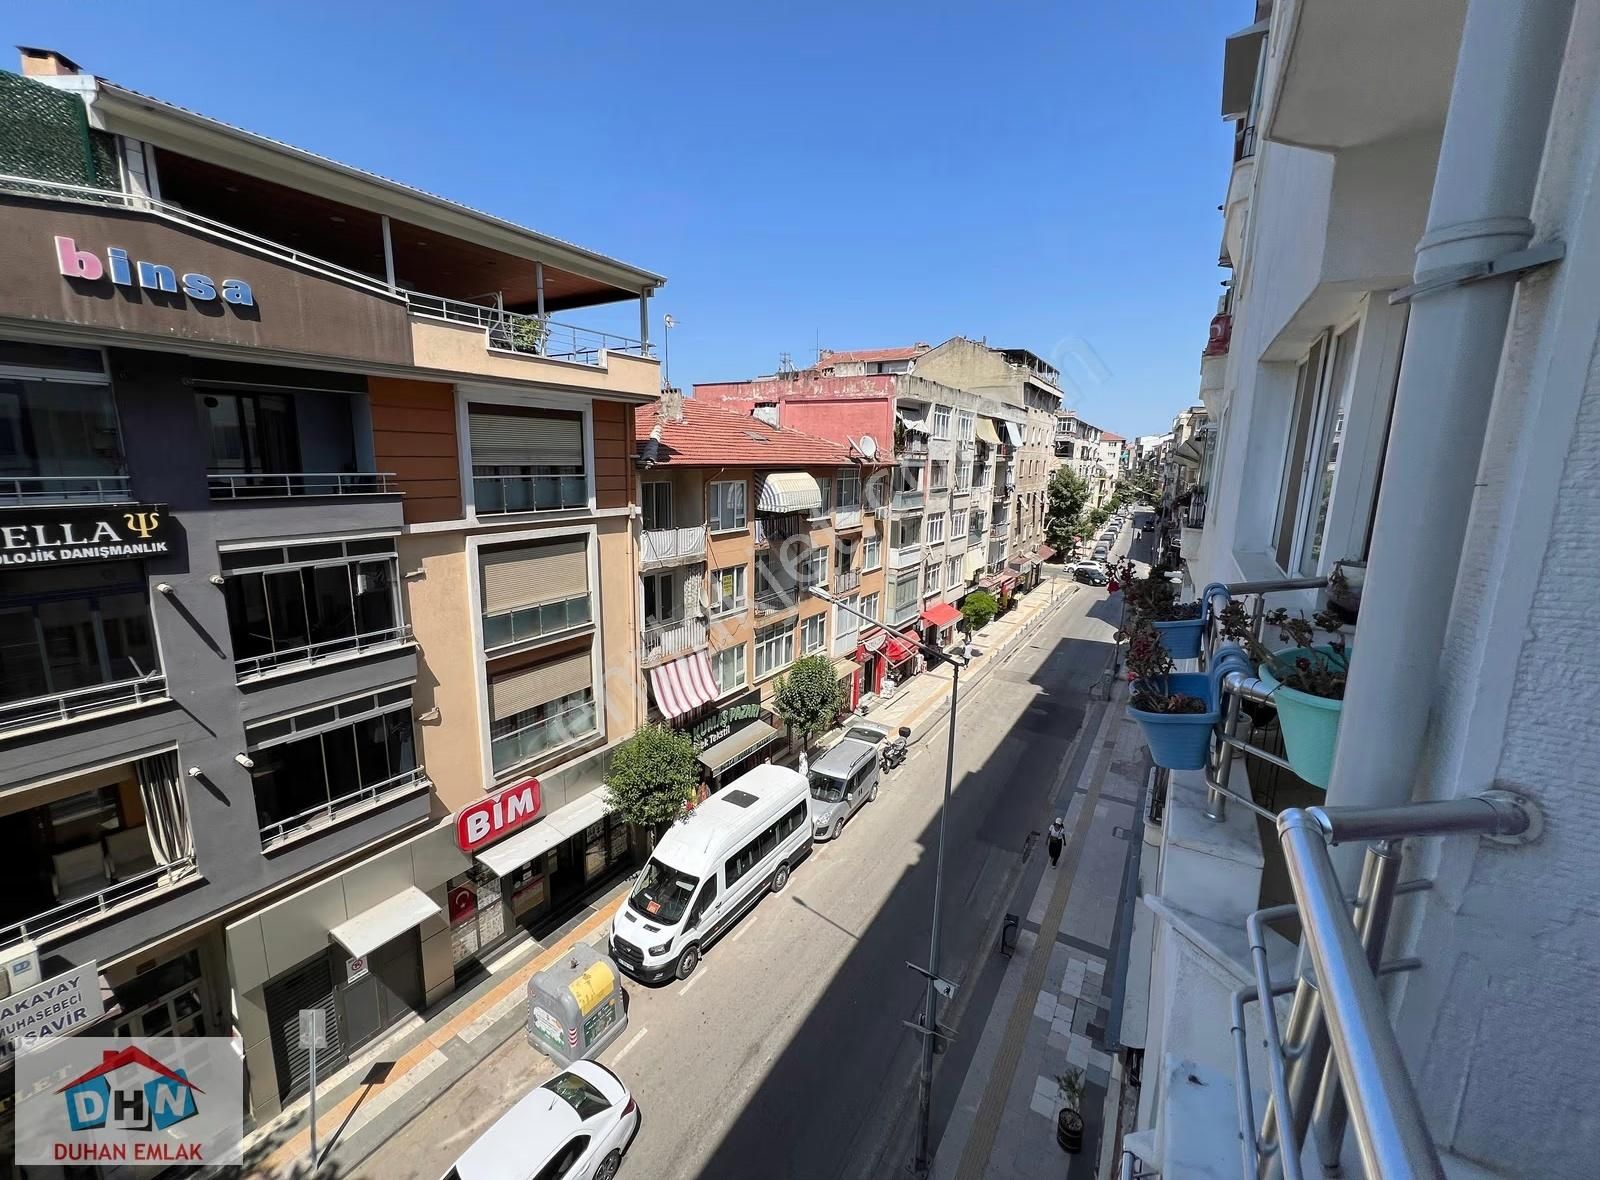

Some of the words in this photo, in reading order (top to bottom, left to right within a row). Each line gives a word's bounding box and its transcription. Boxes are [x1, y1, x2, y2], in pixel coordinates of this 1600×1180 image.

[54, 235, 254, 306] binsa
[0, 521, 123, 549] ELLA
[0, 549, 57, 566] LOJİK
[61, 541, 168, 559] DANIŞMANLIK
[692, 709, 729, 741] KUMAŞ
[729, 703, 762, 722] PAZARI
[709, 725, 731, 744] Tekstil
[466, 787, 535, 843] BİM
[0, 976, 81, 1020] AKAYAY
